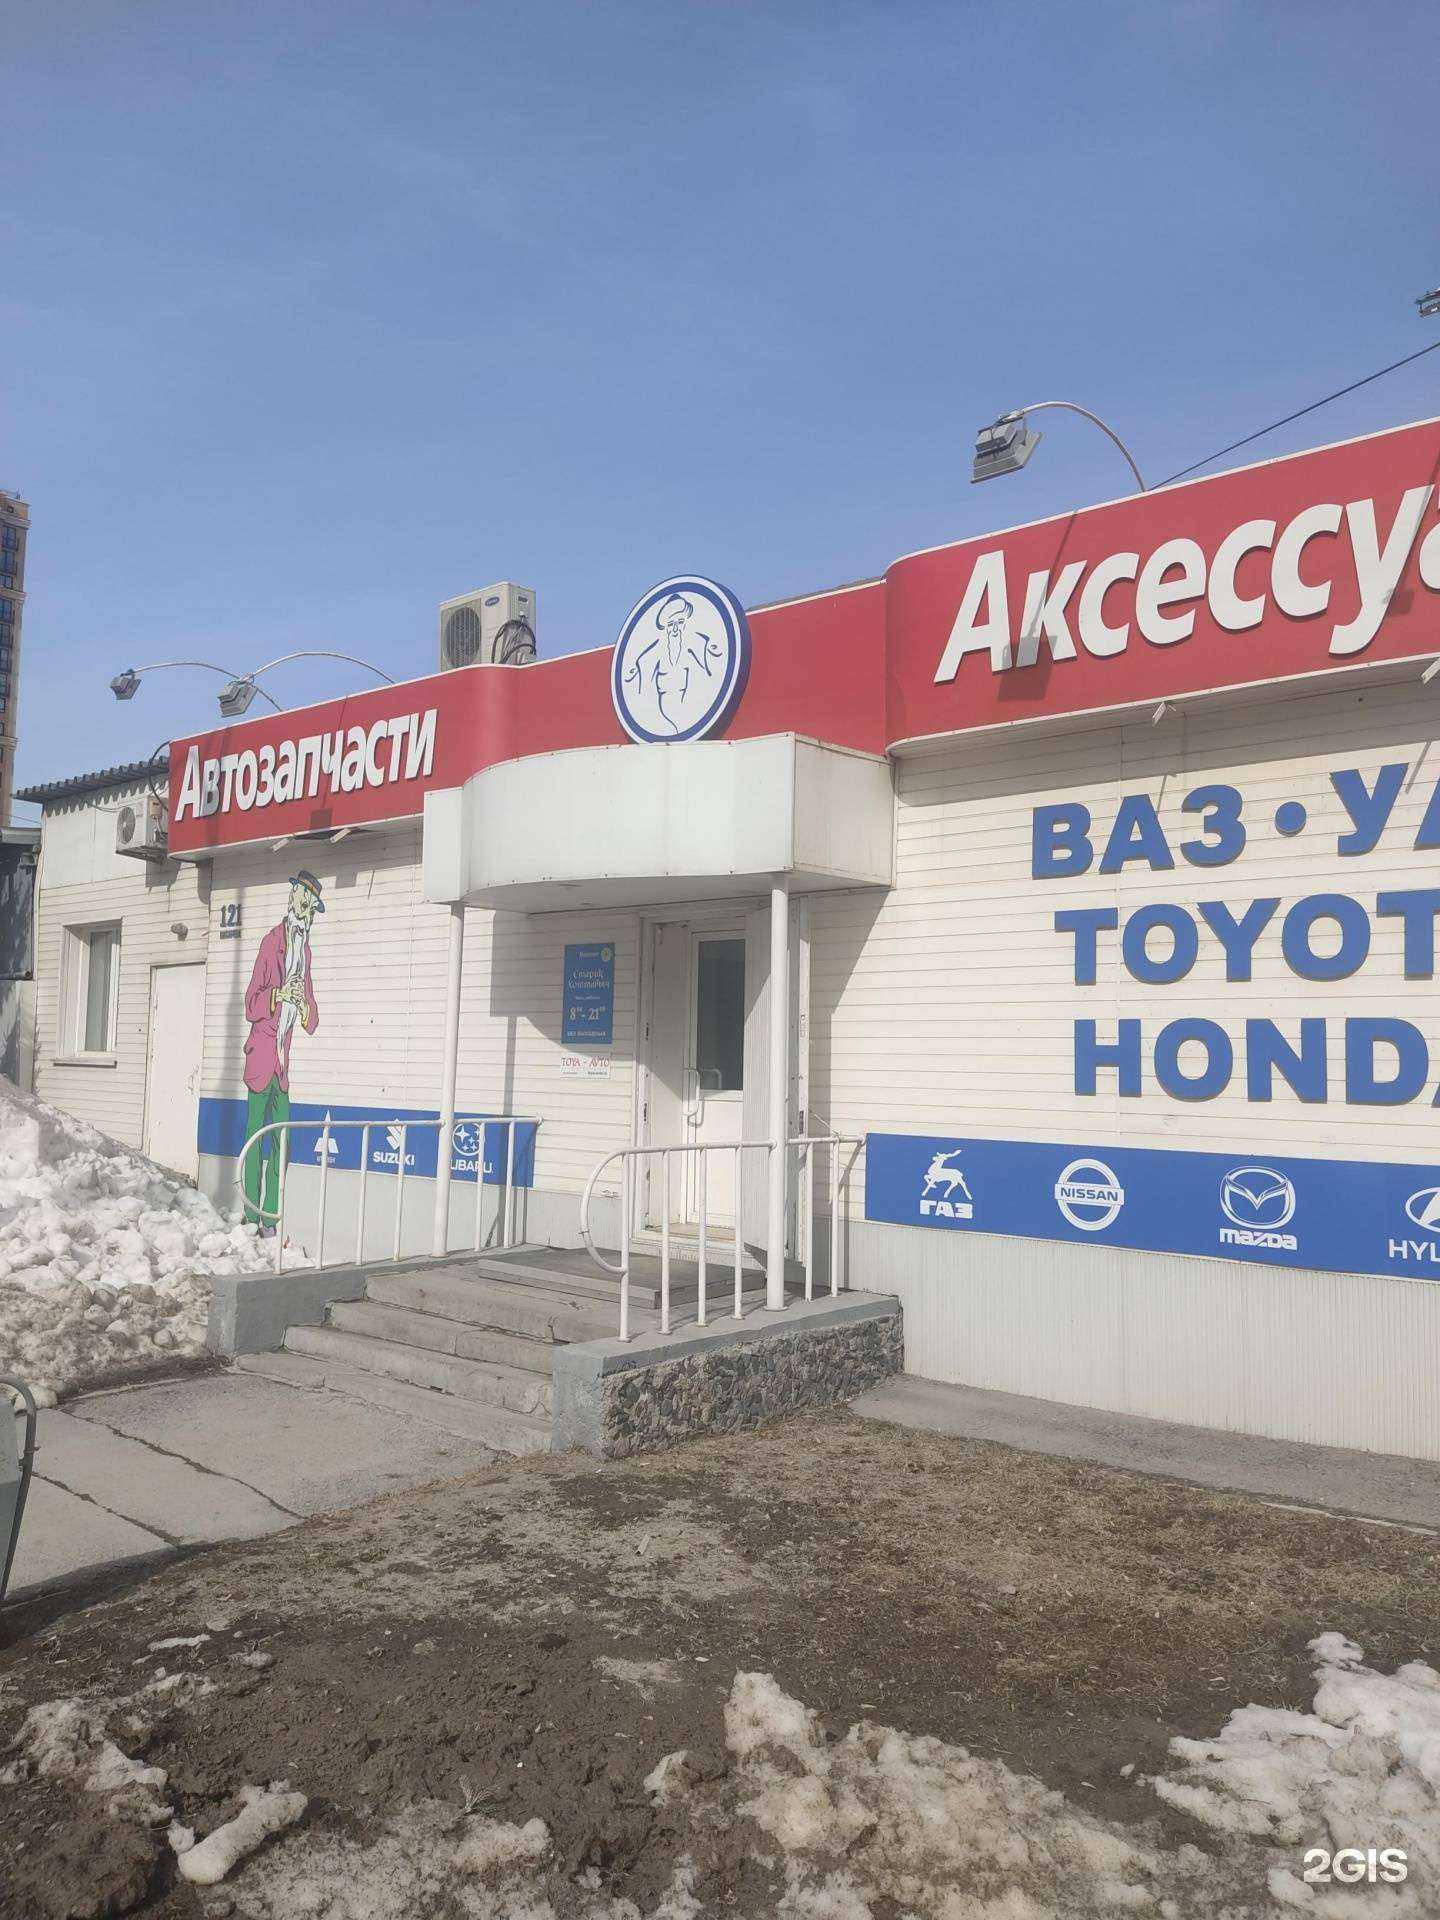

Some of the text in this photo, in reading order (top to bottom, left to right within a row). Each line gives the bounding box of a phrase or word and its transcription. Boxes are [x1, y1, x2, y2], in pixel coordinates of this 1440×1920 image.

[174, 708, 437, 822] Автозапчасти
[1031, 784, 1247, 881] ВАЗ
[1074, 1017, 1440, 1108] HOND
[919, 1199, 973, 1219] ГАЗ
[1060, 1186, 1119, 1202] NISSAN
